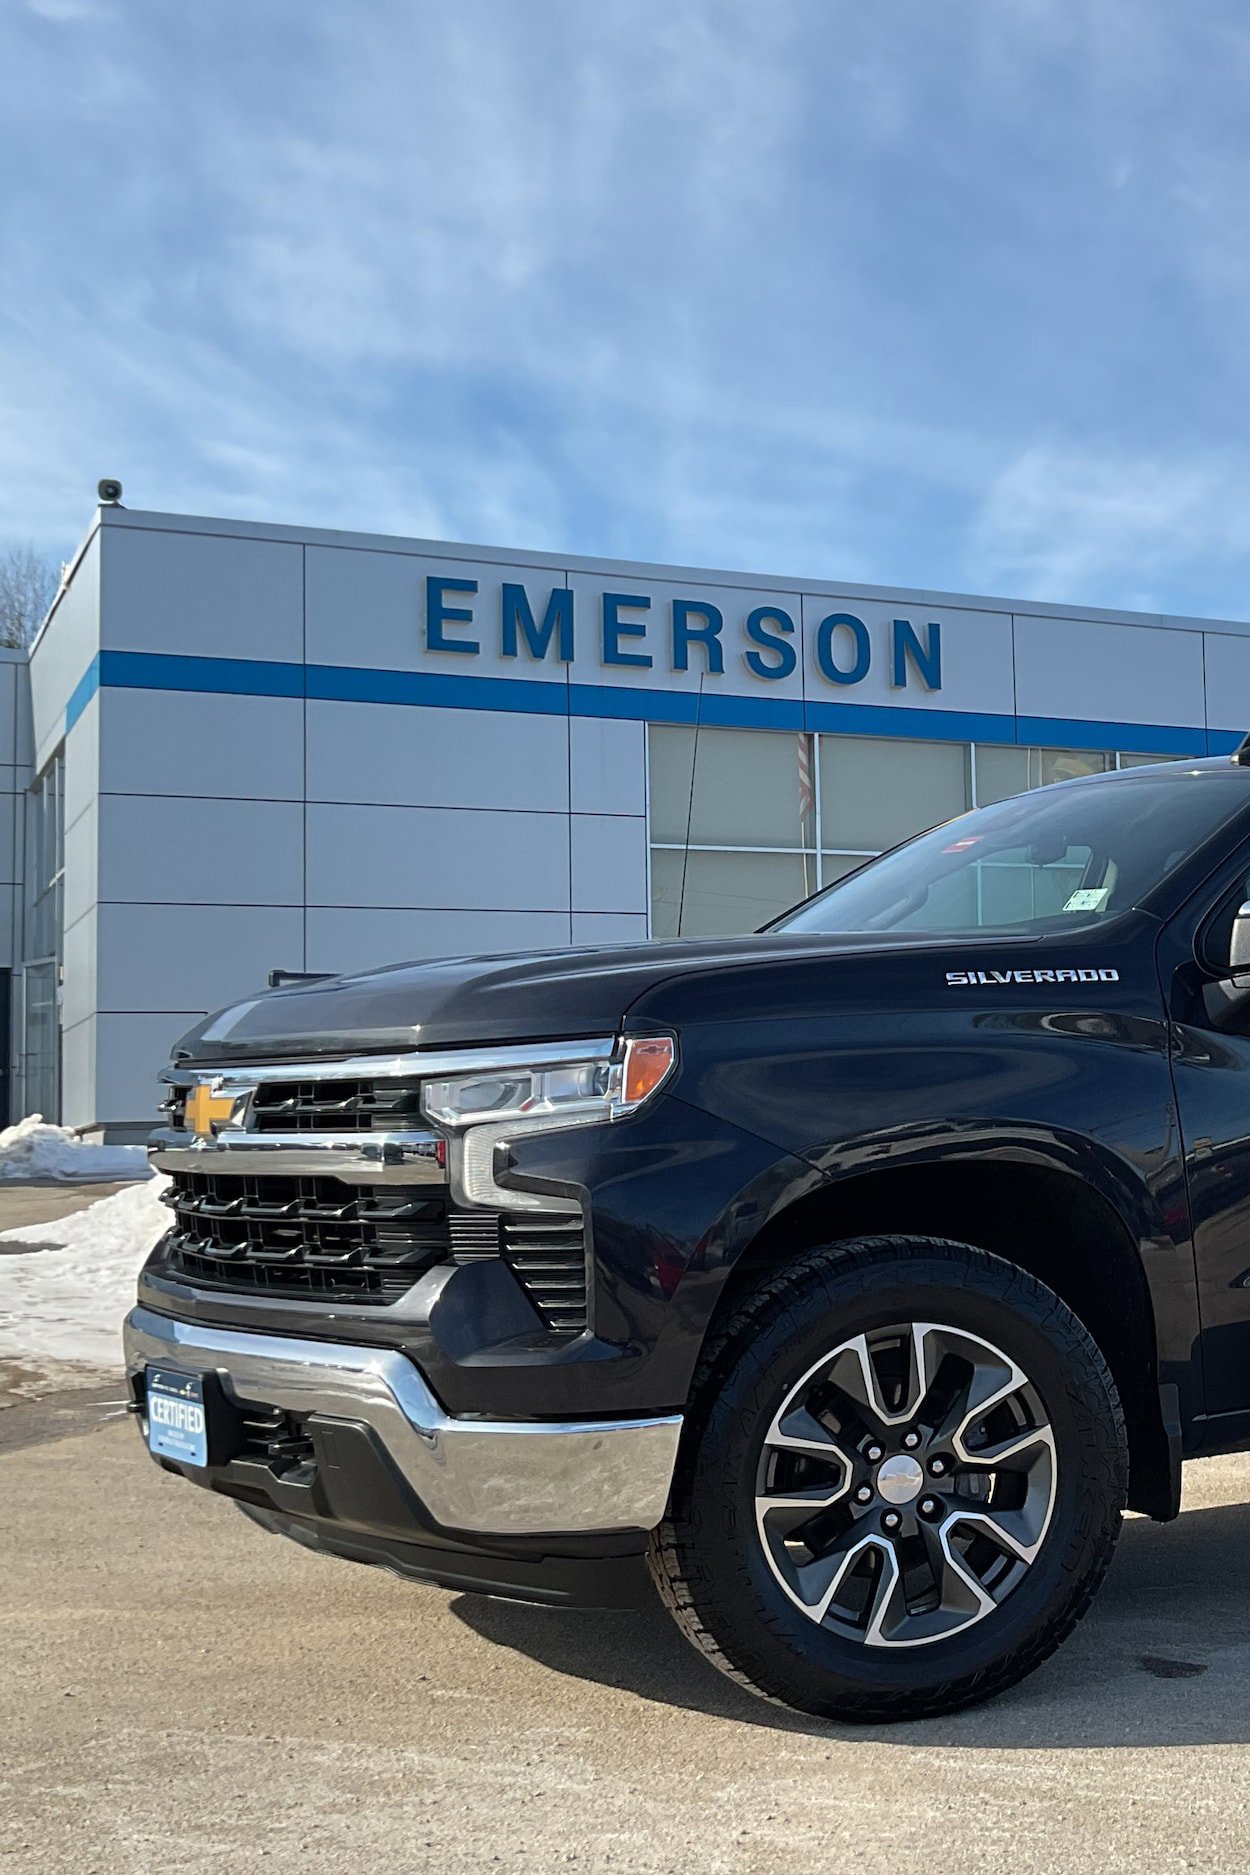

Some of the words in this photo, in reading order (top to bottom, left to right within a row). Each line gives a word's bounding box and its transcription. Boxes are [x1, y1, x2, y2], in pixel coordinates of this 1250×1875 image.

[425, 576, 942, 690] EMERSON
[946, 969, 1119, 985] SILVERADO
[150, 1396, 204, 1434] CERTIFIED
